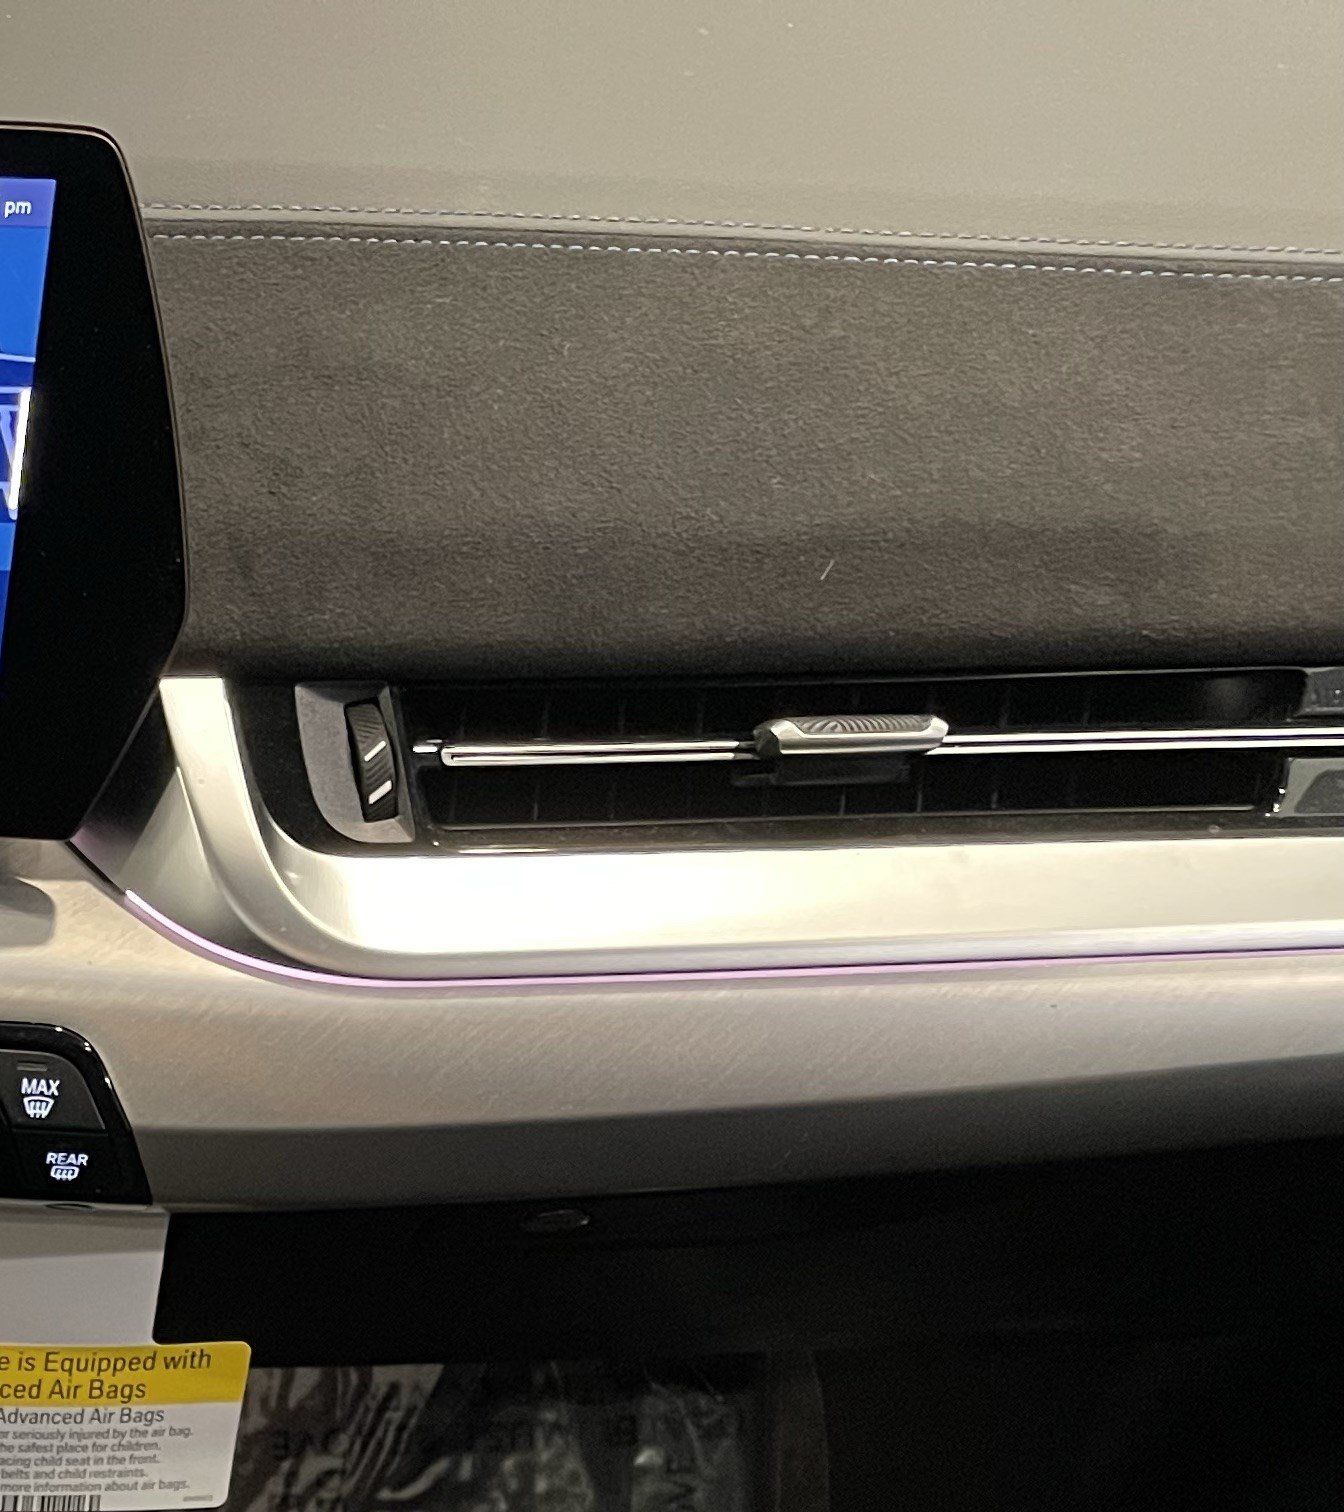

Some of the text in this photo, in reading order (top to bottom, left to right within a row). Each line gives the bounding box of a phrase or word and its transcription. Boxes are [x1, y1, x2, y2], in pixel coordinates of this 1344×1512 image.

[4, 199, 32, 218] pm
[21, 1077, 61, 1096] MAX
[45, 1152, 89, 1166] REAR
[17, 1350, 36, 1372] is
[45, 1348, 157, 1377] Equipped
[164, 1347, 213, 1370] with
[48, 1378, 82, 1400] Air
[89, 1379, 146, 1405] Bags
[88, 1407, 115, 1425] Air
[120, 1406, 165, 1427] Bags
[13, 1429, 65, 1441] seriously
[69, 1428, 110, 1442] injured
[112, 1428, 127, 1442] by
[129, 1427, 148, 1438] the
[151, 1426, 165, 1437] air
[169, 1425, 193, 1438] bag.
[18, 1442, 55, 1453] safest
[56, 1442, 88, 1455] place
[91, 1441, 109, 1452] for
[111, 1440, 161, 1452] children.
[33, 1455, 61, 1467] child
[65, 1454, 90, 1466] seat
[93, 1454, 104, 1465] in
[106, 1454, 126, 1465] the
[129, 1453, 160, 1465] front.
[1, 1468, 29, 1480] belts
[32, 1468, 55, 1480] and
[58, 1468, 87, 1479] child
[89, 1467, 147, 1478] restraints.
[0, 1482, 31, 1492] more
[33, 1480, 102, 1492] information
[104, 1480, 139, 1492] about
[141, 1480, 156, 1491] air
[159, 1478, 190, 1491] bags.
